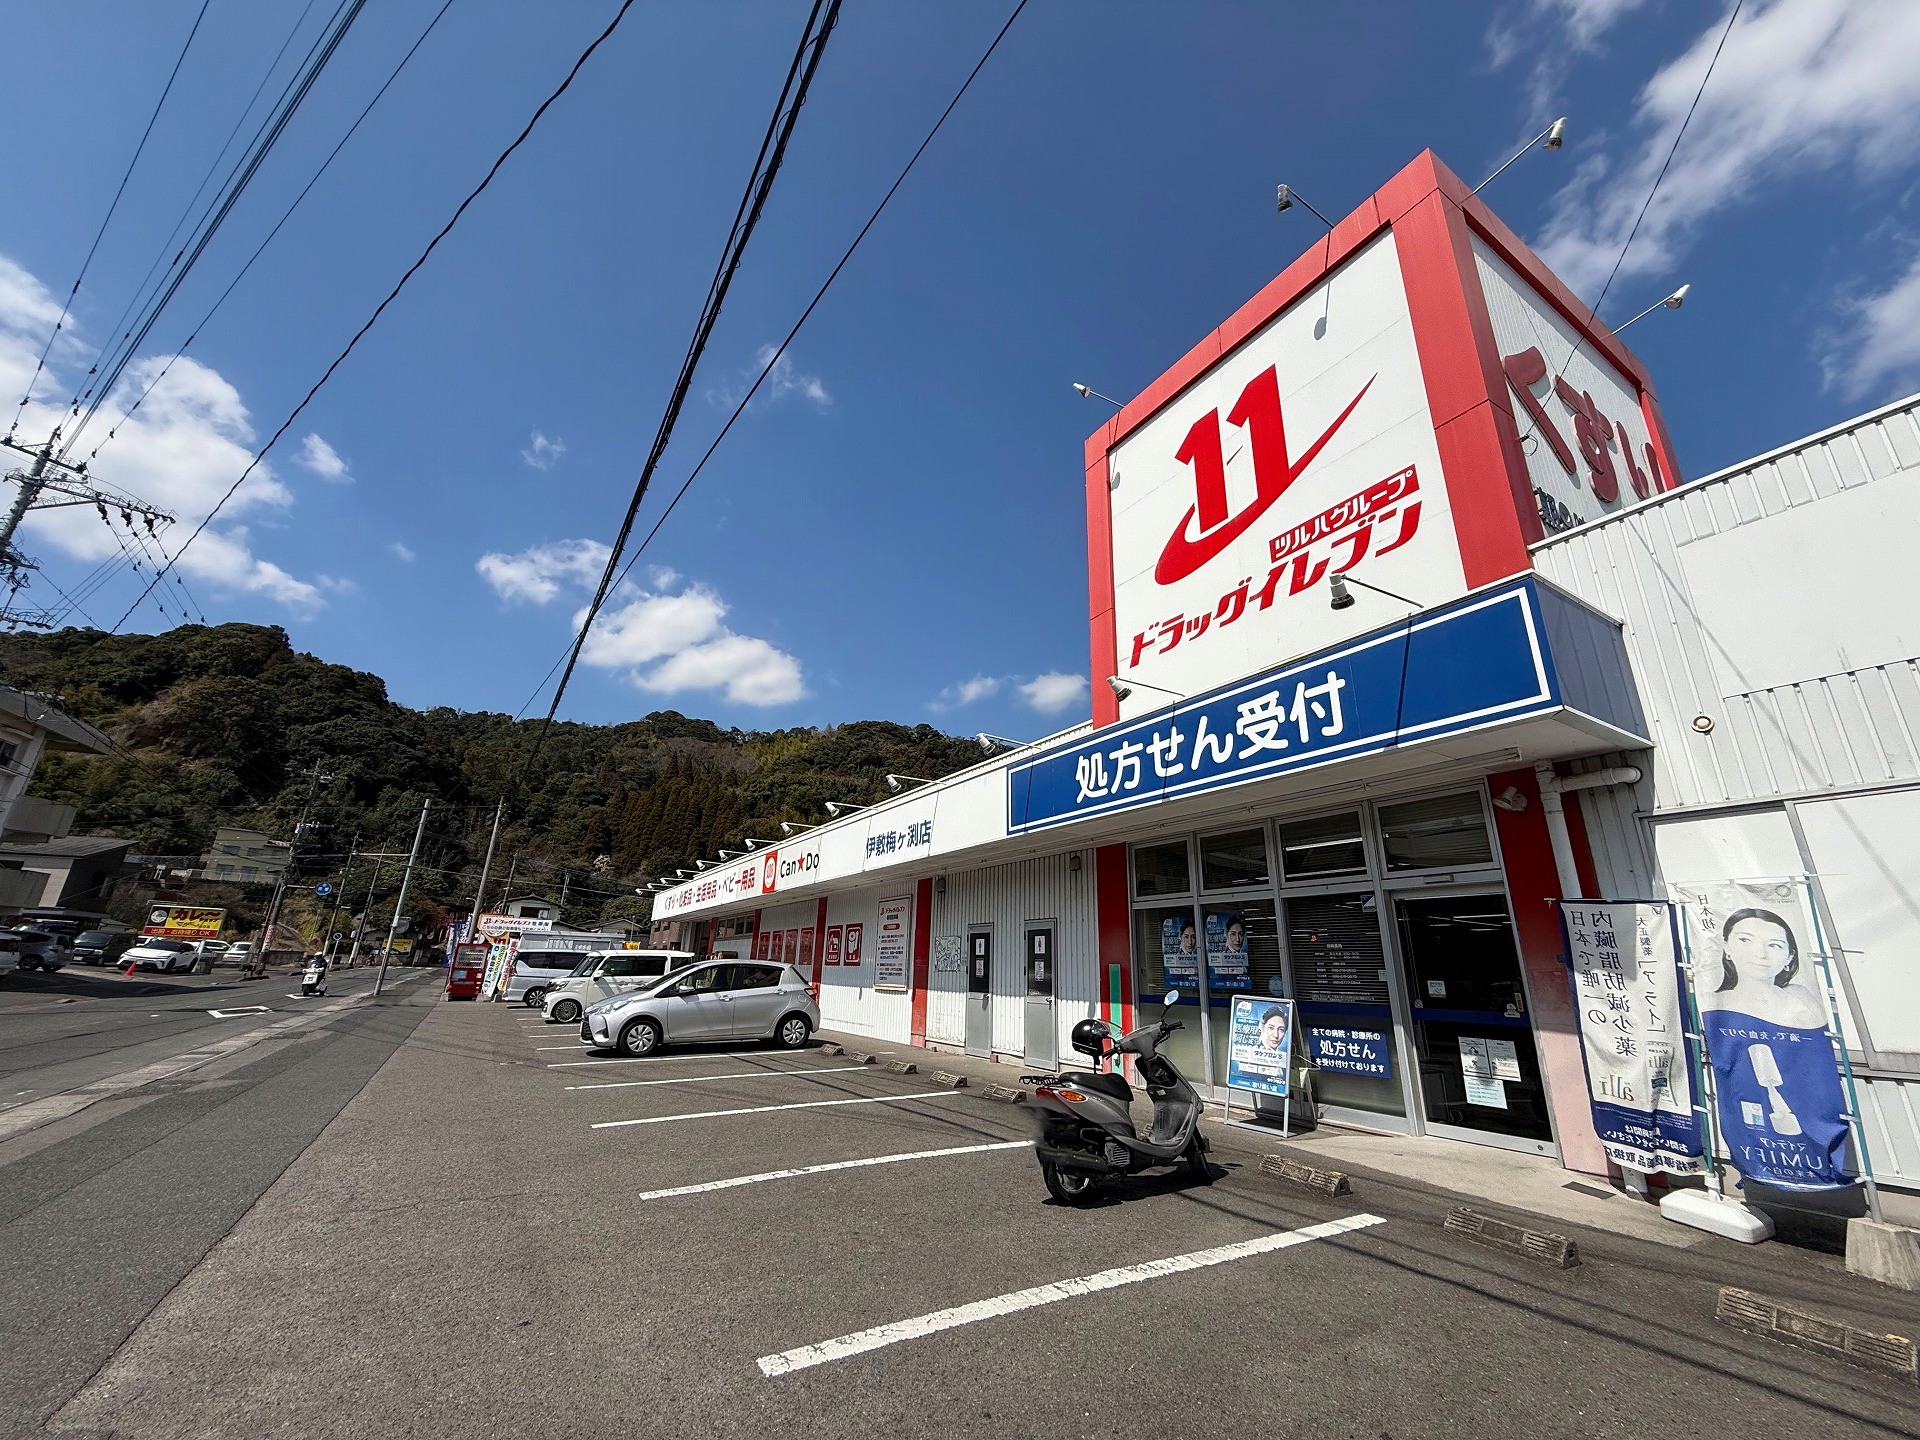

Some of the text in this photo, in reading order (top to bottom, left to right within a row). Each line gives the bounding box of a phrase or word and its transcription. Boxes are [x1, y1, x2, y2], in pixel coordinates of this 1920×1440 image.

[1274, 468, 1415, 558] ツルハグループ
[1130, 501, 1423, 668] ドラッグイレブン
[1075, 670, 1346, 804] 処方せん受付
[1312, 1028, 1381, 1041] 全ての病院・診療所の
[1319, 1040, 1376, 1060] 処方せん
[1315, 1057, 1385, 1074] を受け付けております
